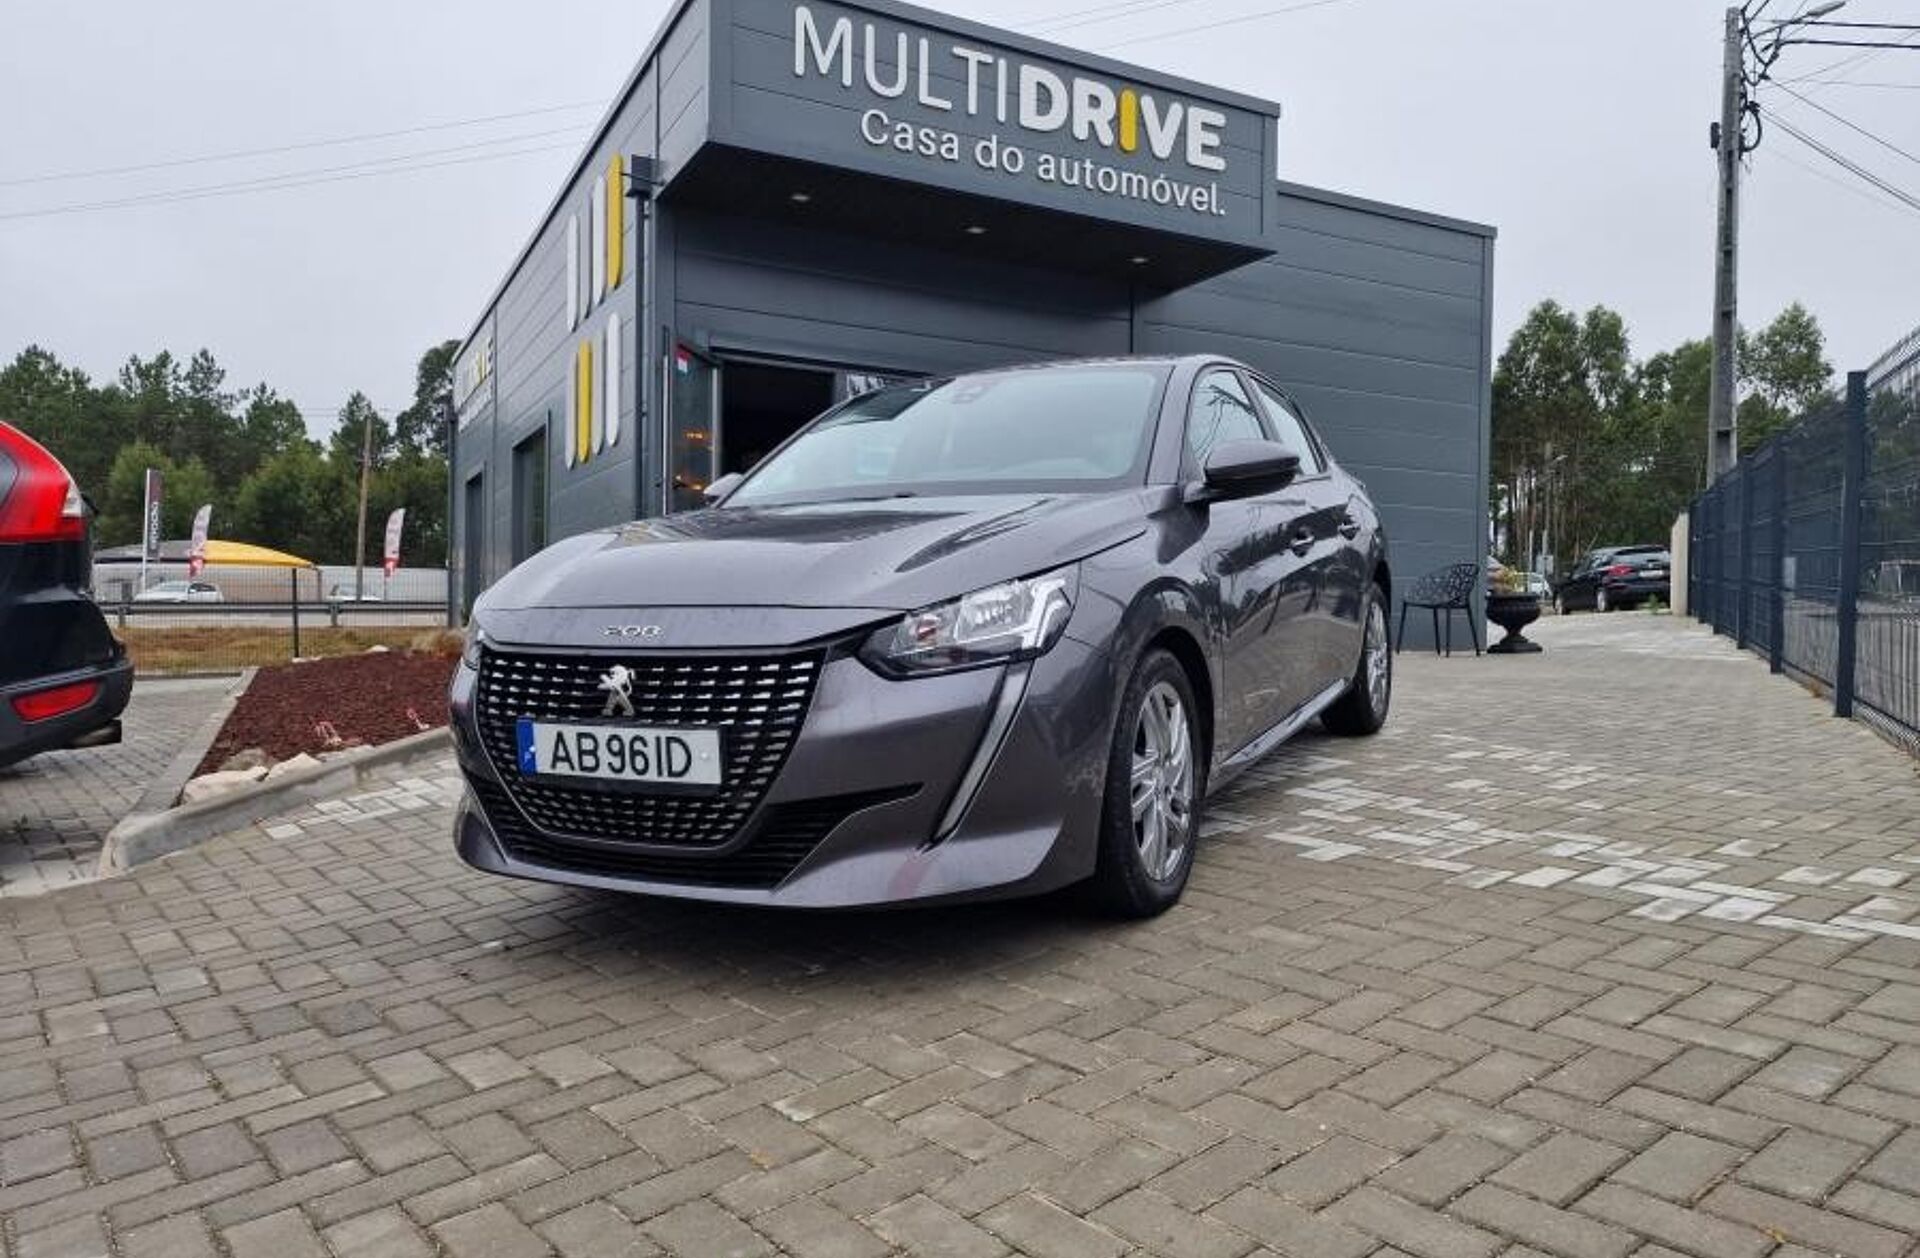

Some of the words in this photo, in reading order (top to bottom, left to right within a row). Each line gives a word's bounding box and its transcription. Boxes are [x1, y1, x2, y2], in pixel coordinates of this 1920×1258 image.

[794, 5, 1227, 171] MULTIDRIVE
[861, 109, 959, 162] Casa
[974, 137, 1024, 174] do
[1037, 152, 1227, 217] automóvel.
[550, 730, 693, 779] AB96ID
